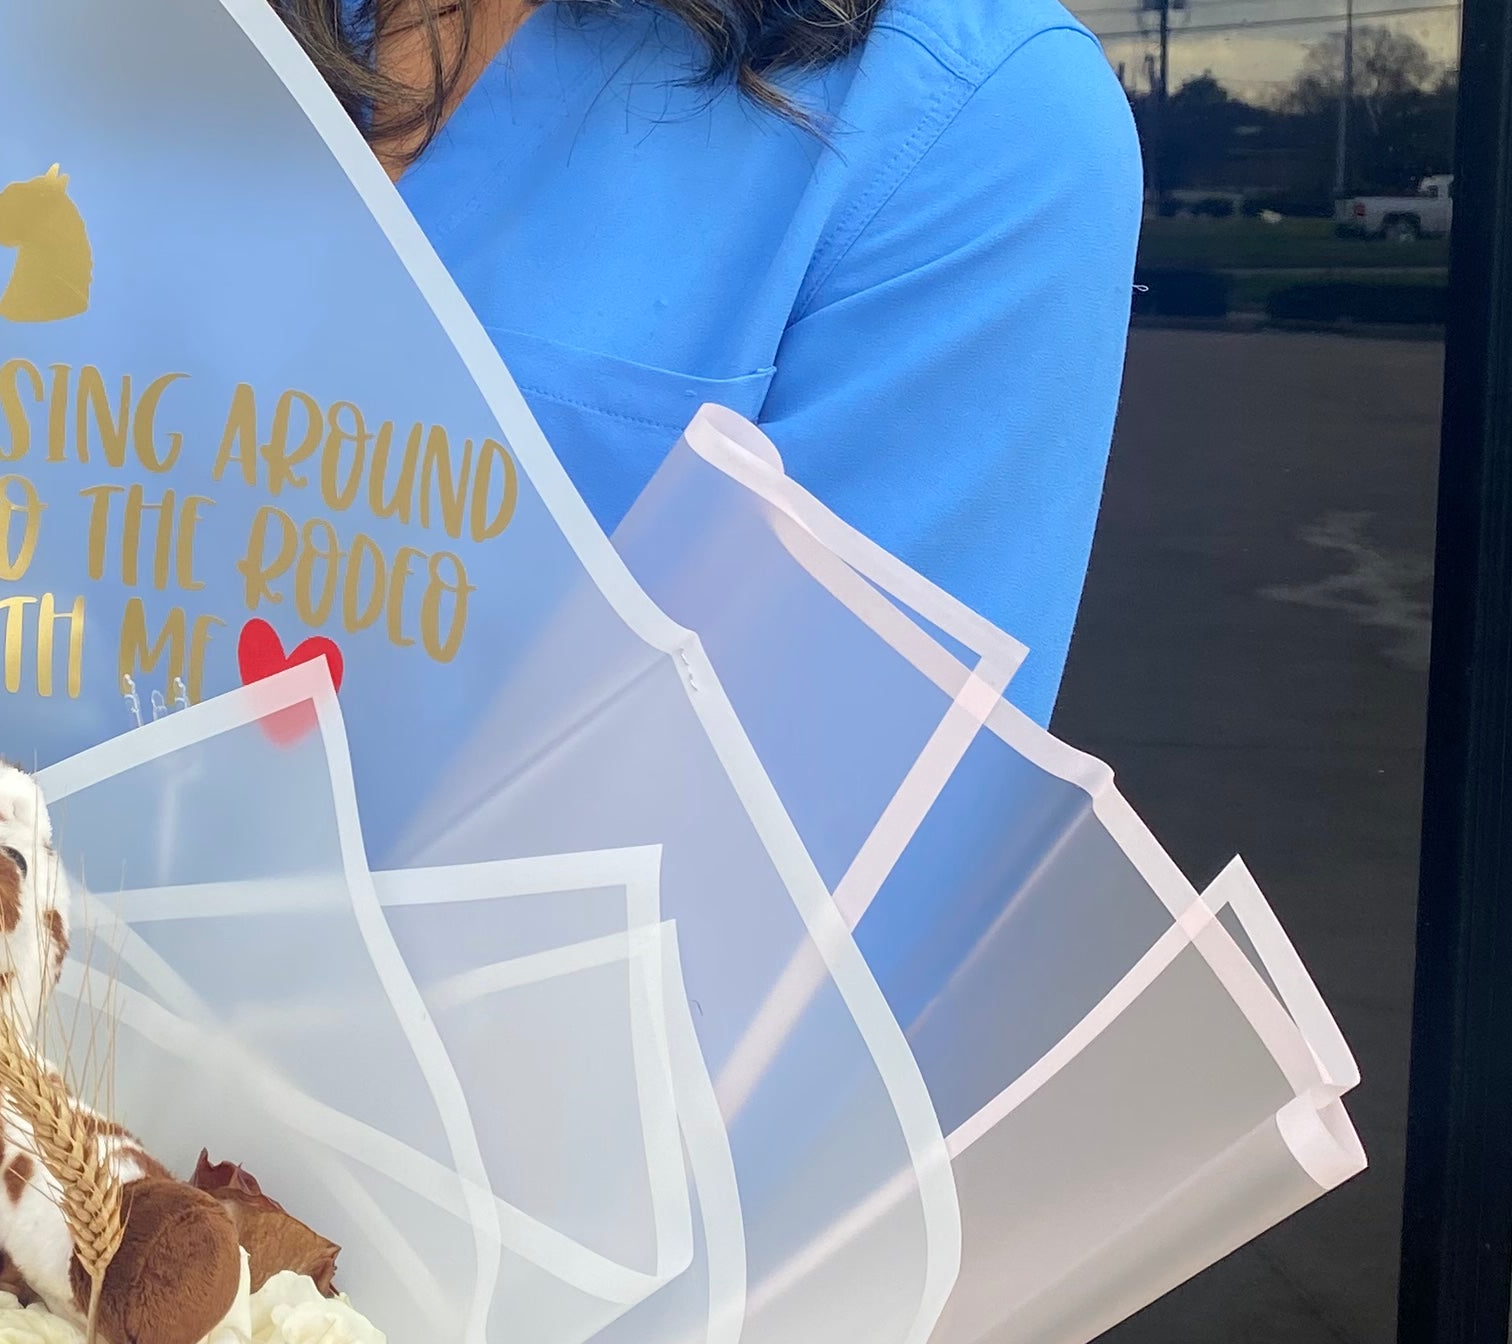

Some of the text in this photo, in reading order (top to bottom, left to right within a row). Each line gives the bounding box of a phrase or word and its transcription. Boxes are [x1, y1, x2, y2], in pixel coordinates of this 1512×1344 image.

[214, 383, 517, 542] AROUND
[78, 484, 214, 591] THE
[237, 506, 476, 663] RODEO
[118, 596, 226, 709] ME
